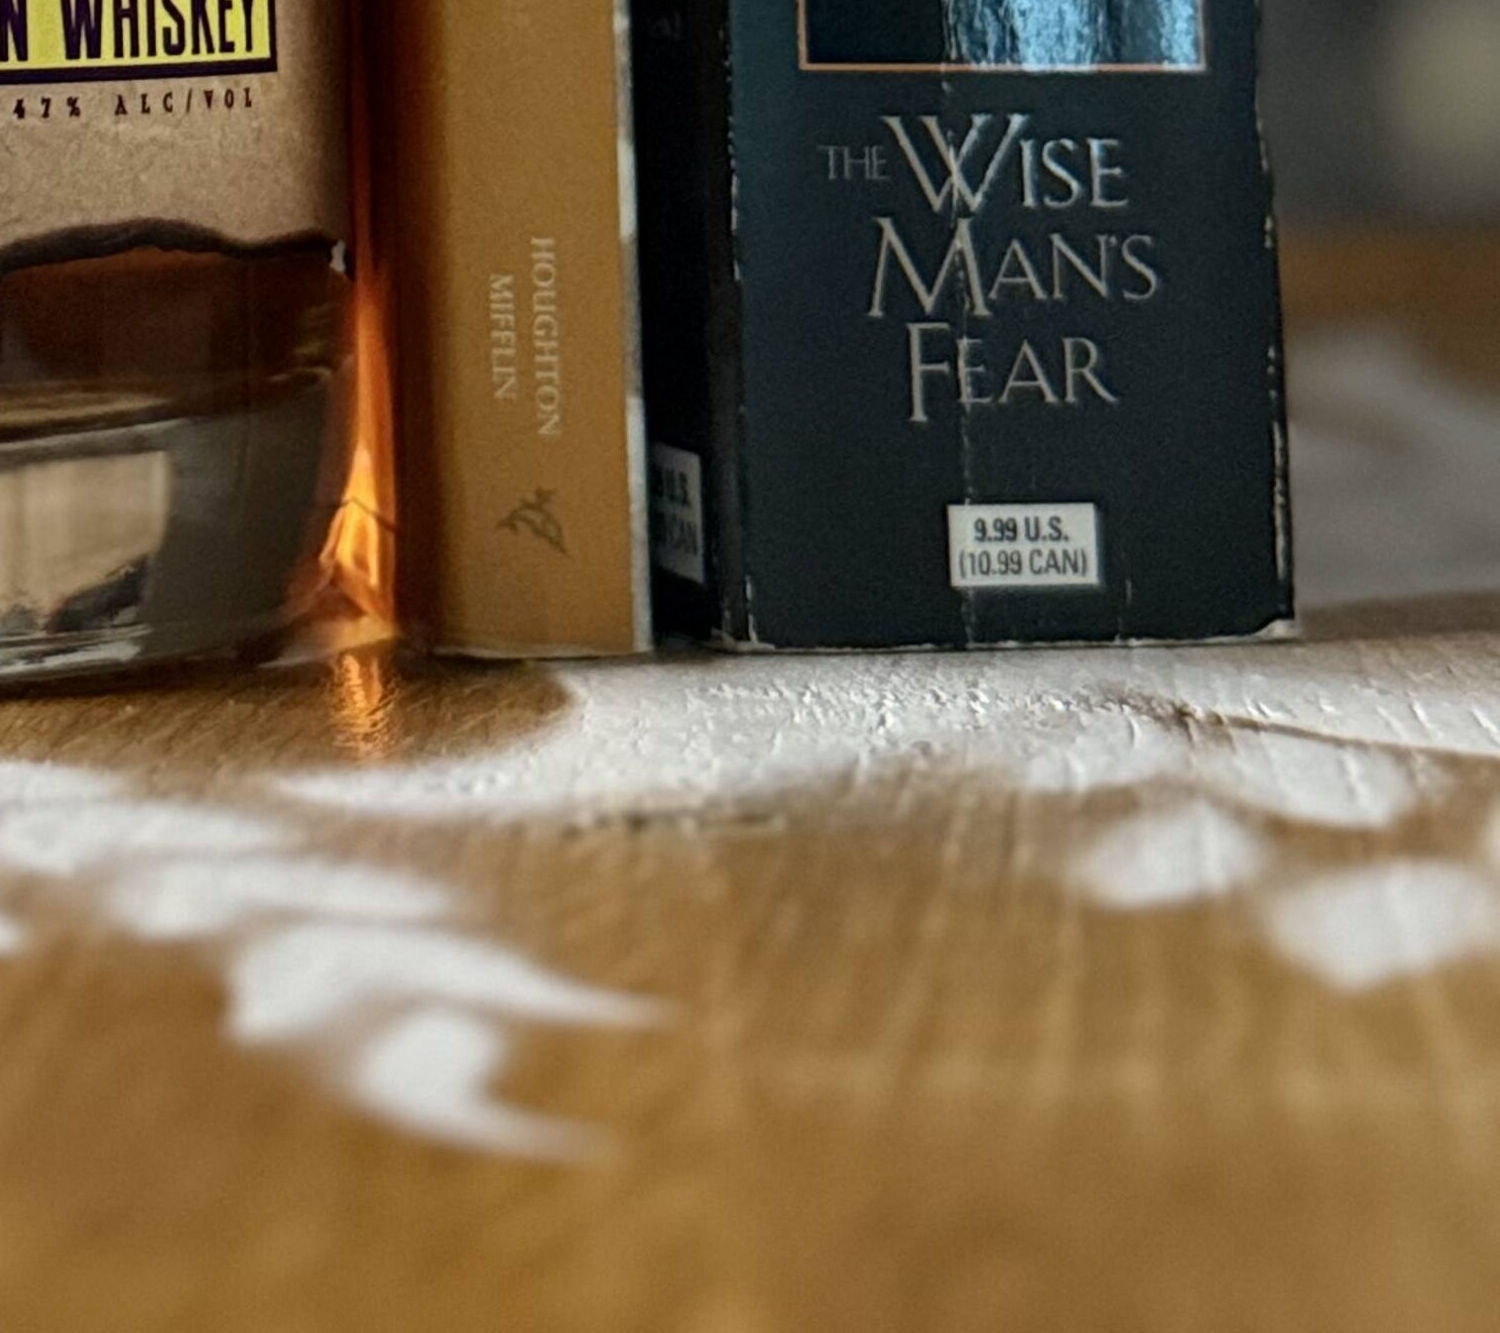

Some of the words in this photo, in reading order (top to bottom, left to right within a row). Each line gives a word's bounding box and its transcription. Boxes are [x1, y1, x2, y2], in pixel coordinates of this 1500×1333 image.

[13, 96, 81, 119] 47%
[115, 87, 253, 116] ALC/VOL
[818, 144, 891, 180] THE
[882, 113, 1129, 213] WISE
[868, 217, 1158, 317] MAN'S
[490, 273, 517, 400] MIFFLIN
[531, 237, 562, 435] HOUGHTON
[907, 322, 1119, 422] FEAR
[959, 551, 1023, 577] (10.99
[1029, 549, 1088, 577] CAN)
[973, 517, 1019, 543] 9.99
[1024, 517, 1070, 542] U.S.
